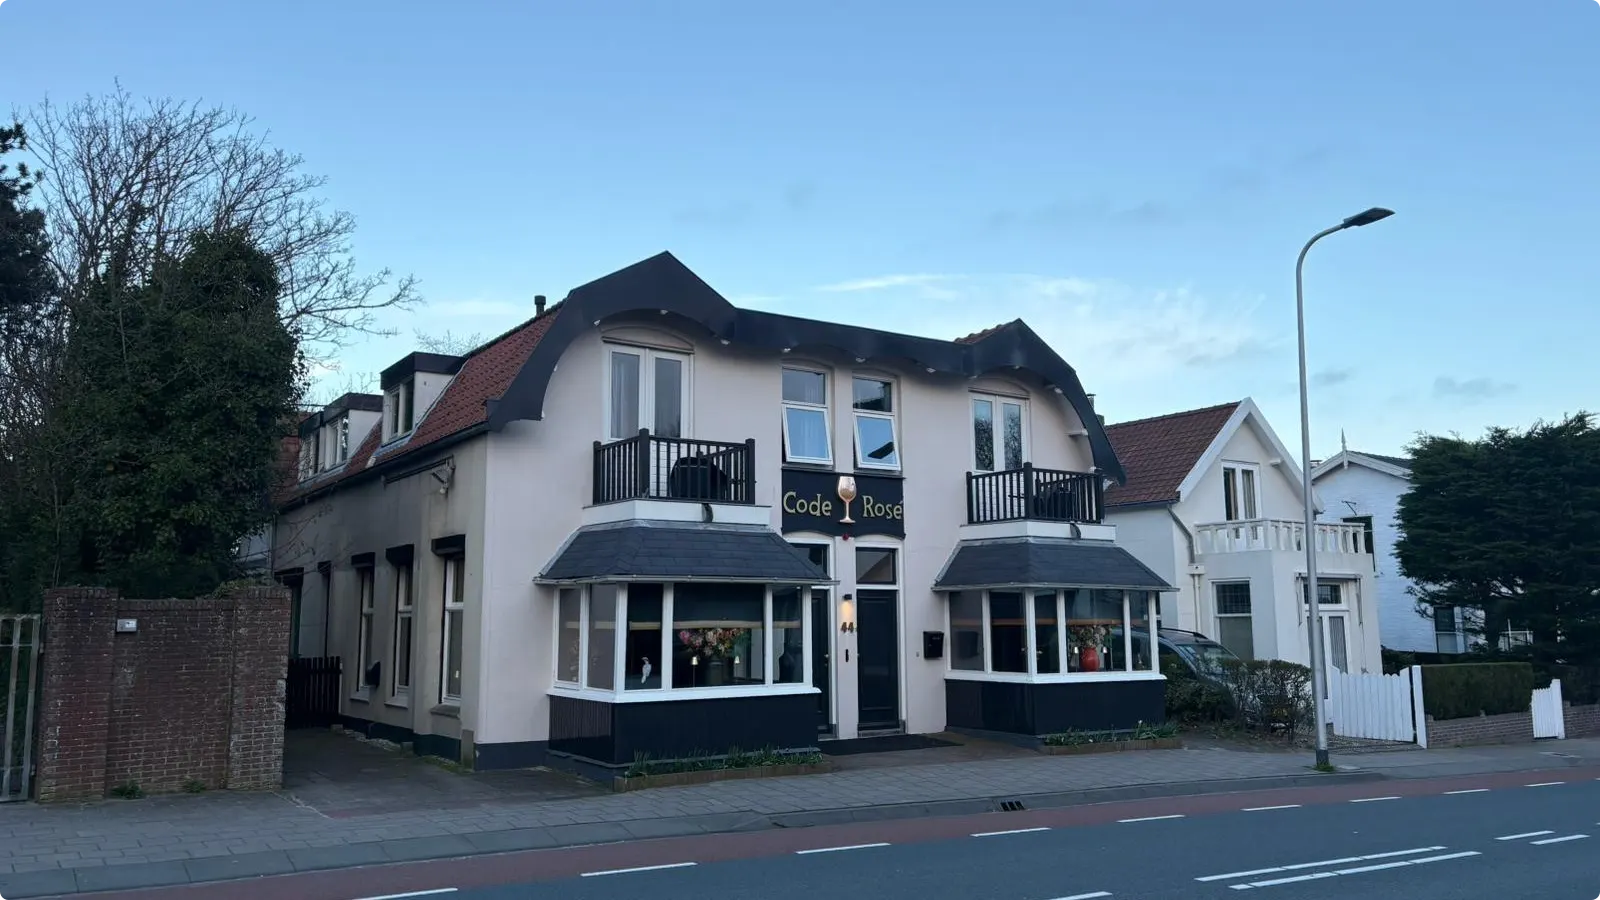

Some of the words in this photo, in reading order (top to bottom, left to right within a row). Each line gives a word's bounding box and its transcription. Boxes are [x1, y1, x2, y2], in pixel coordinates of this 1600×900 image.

[783, 491, 832, 516] Code
[862, 495, 903, 519] Rosé
[840, 621, 854, 633] 44
